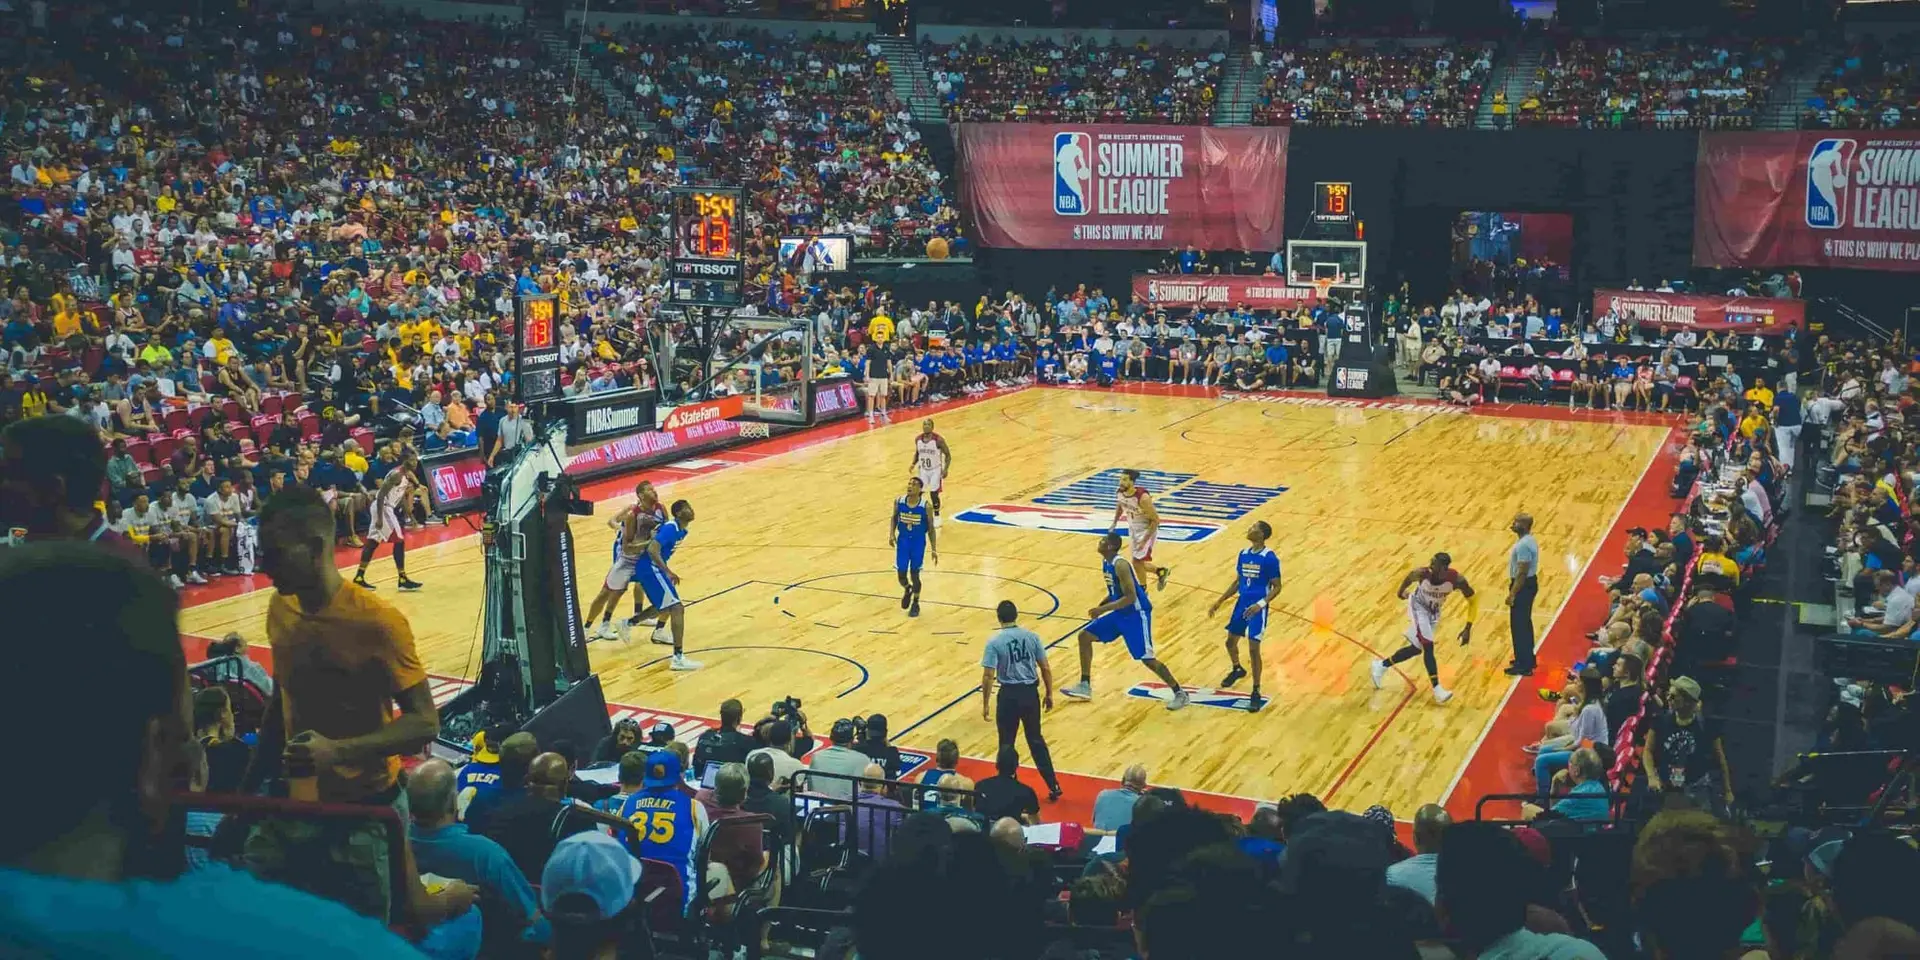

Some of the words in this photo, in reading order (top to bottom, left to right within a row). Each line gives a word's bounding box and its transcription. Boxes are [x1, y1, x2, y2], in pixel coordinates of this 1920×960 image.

[1098, 143, 1183, 179] SUMMER
[1098, 178, 1169, 214] LEAGUE
[1327, 185, 1347, 195] 7:54
[692, 193, 735, 217] 7:54
[1059, 195, 1077, 209] NBA
[1329, 196, 1344, 212] 13
[1811, 206, 1830, 221] NBA
[698, 218, 729, 256] 13
[1082, 225, 1101, 240] THIS
[1102, 225, 1111, 240] IS
[1112, 225, 1131, 240] WHY
[1131, 225, 1144, 240] WE
[1144, 225, 1164, 240] PLAY
[1834, 240, 1854, 257] THIS
[1855, 240, 1865, 257] IS
[1867, 241, 1889, 259] WHY
[1890, 241, 1904, 259] WE
[692, 264, 737, 275] TISSOT
[1159, 286, 1197, 302] SUMMER
[530, 300, 553, 319] 7:54
[1662, 304, 1696, 324] LEAGUE
[533, 353, 559, 365] TISSOT
[586, 407, 640, 434] #NBASummer
[613, 433, 649, 460] SUMMER
[645, 430, 678, 453] LEAGUE
[443, 473, 457, 493] TV
[562, 552, 570, 586] RESORTS
[1007, 639, 1031, 664] 134
[467, 773, 500, 785] WEST
[636, 798, 675, 809] DURANT
[629, 811, 676, 844] 35
